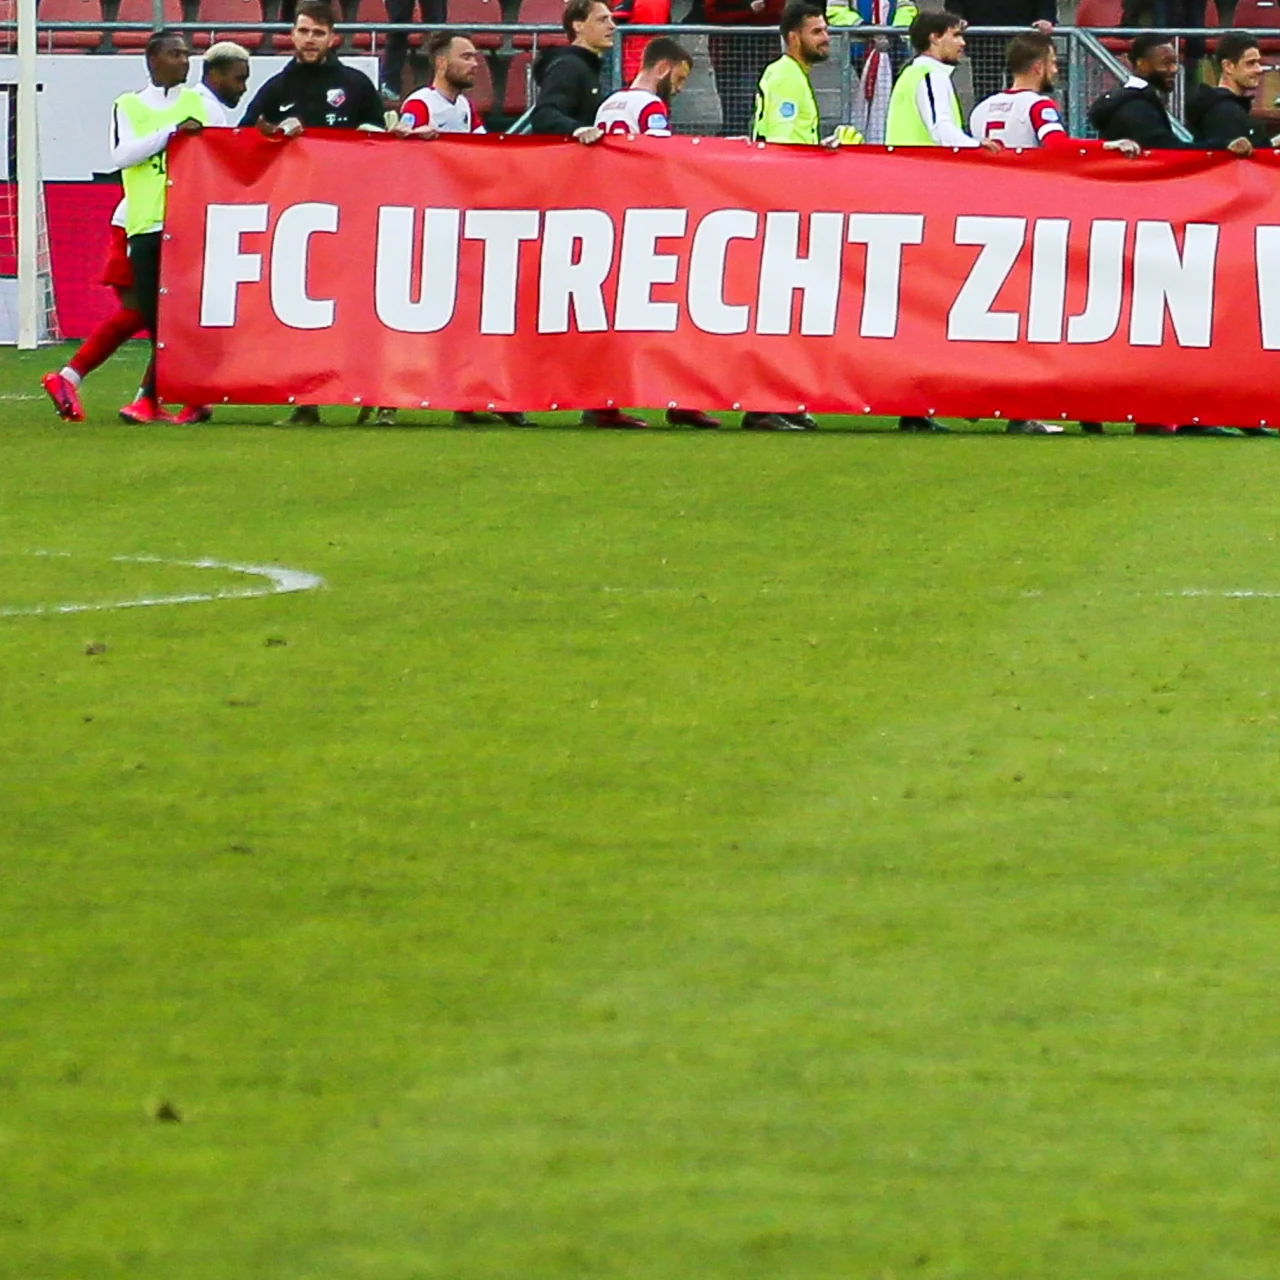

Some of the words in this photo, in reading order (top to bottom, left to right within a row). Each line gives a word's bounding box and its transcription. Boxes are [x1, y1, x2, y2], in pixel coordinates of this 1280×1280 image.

[199, 202, 340, 329] FC
[373, 206, 925, 340] UTRECHT
[946, 214, 1220, 348] ZIJN
